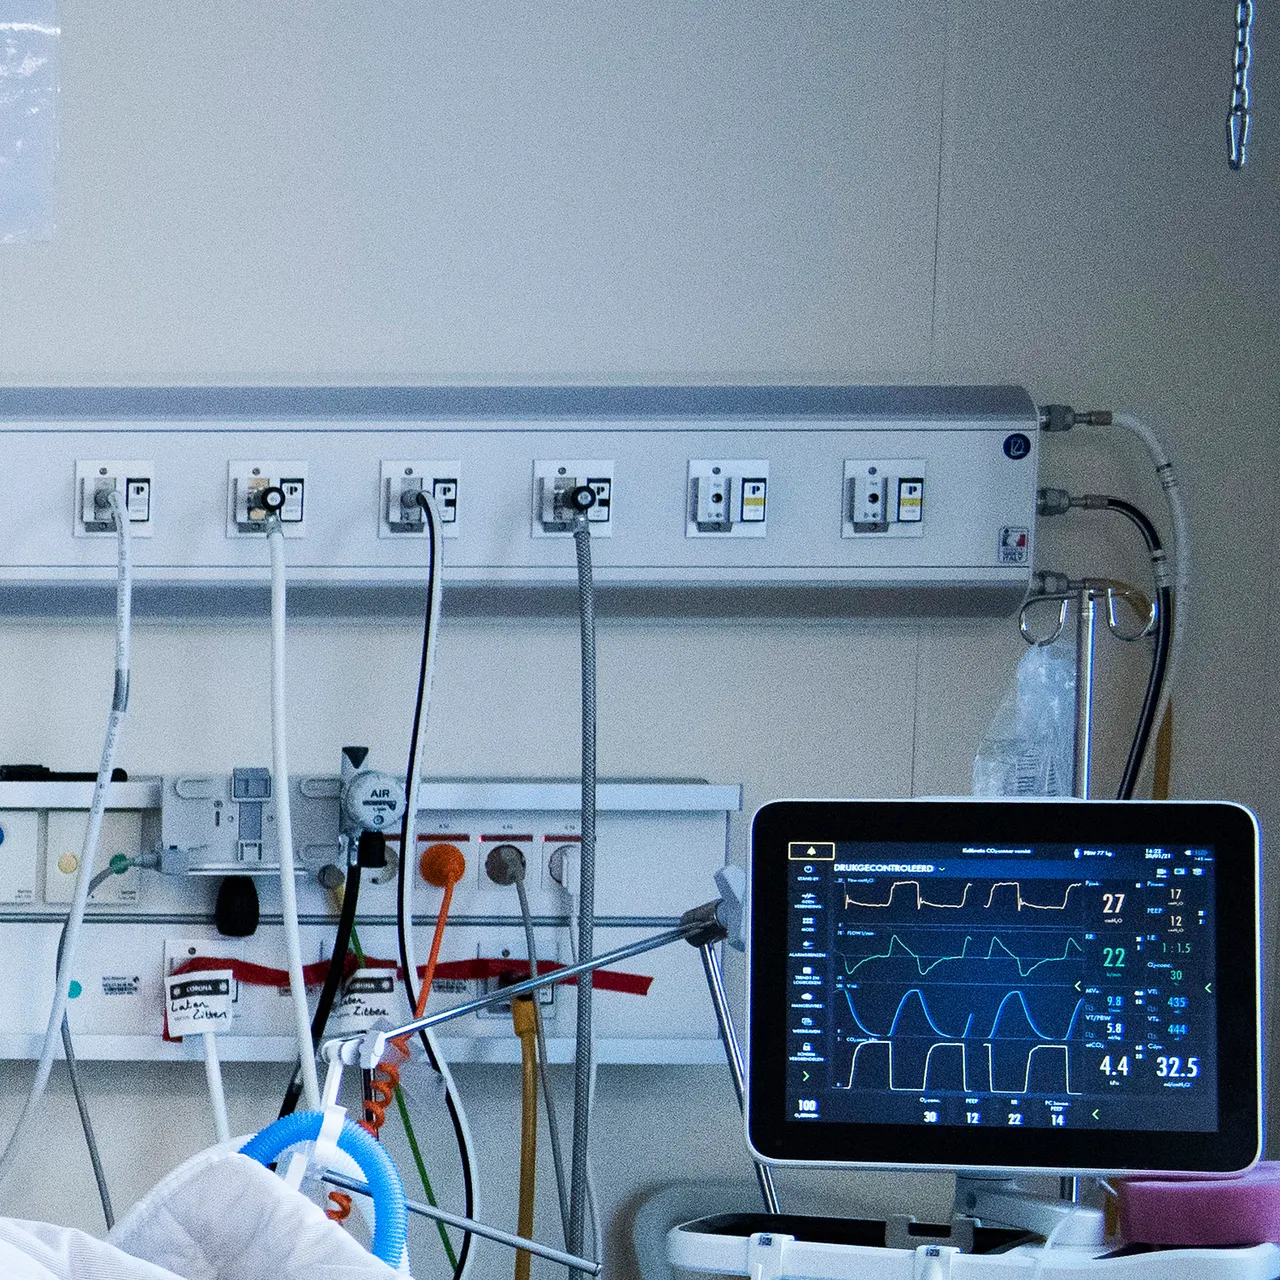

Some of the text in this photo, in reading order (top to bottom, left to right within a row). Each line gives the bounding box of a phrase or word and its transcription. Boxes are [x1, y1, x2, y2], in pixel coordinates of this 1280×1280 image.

[371, 789, 390, 798] AIR
[834, 864, 934, 872] DRUKGECONTROLEERD
[1170, 889, 1182, 899] 17
[1102, 893, 1125, 913] 27
[1170, 916, 1182, 926] 12
[1103, 948, 1125, 967] 22
[1171, 970, 1183, 980] 30
[1107, 996, 1122, 1006] 9.8
[1168, 997, 1186, 1008] 435
[1107, 1023, 1122, 1033] 5.8
[1168, 1024, 1186, 1034] 444
[1100, 1056, 1129, 1076] 4.4
[1156, 1056, 1199, 1078] 32.5
[798, 1100, 816, 1111] 100
[924, 1112, 937, 1122] 30
[967, 1113, 980, 1123] 12
[1008, 1114, 1023, 1125] 22
[1051, 1114, 1064, 1126] 14
